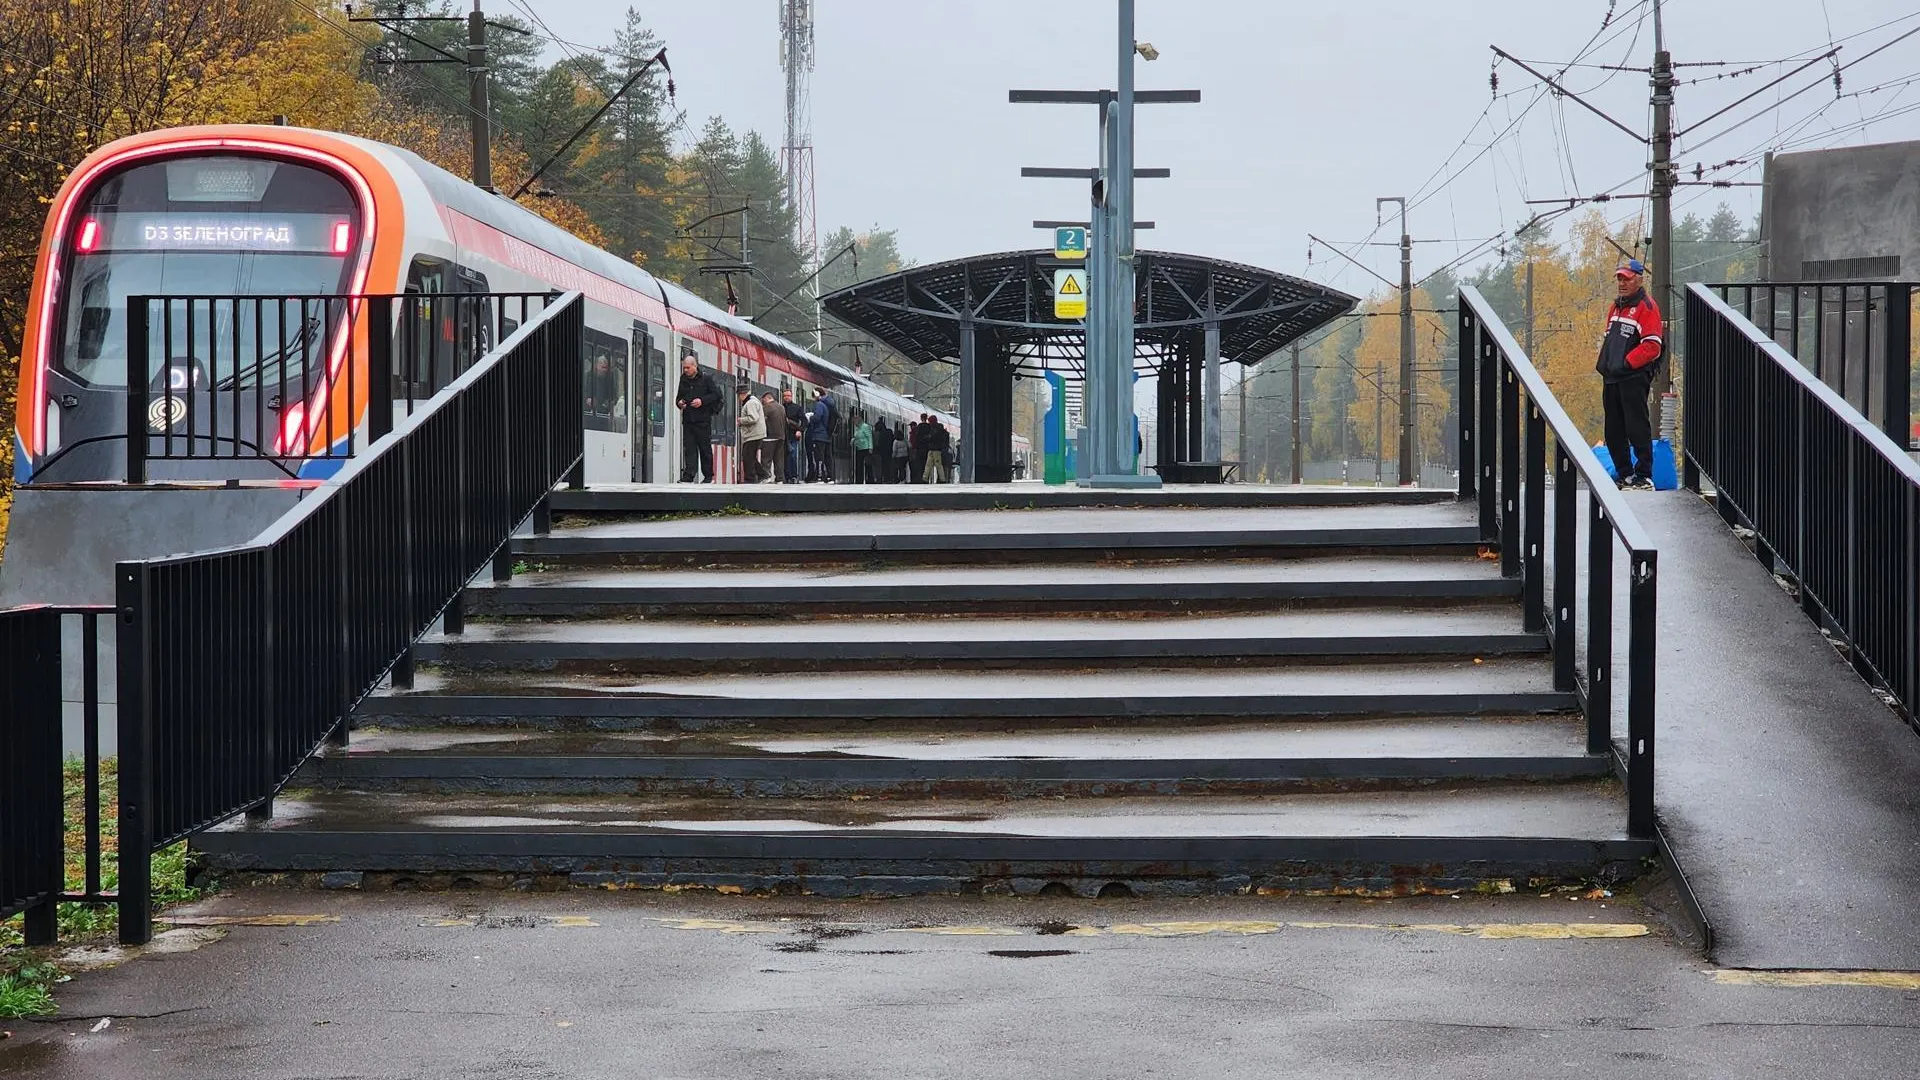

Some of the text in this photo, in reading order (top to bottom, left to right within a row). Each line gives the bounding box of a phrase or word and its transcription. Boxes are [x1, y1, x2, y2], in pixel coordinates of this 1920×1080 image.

[145, 226, 289, 243] D3 ЗЕЛЕНОГРАД
[1065, 230, 1075, 244] 2
